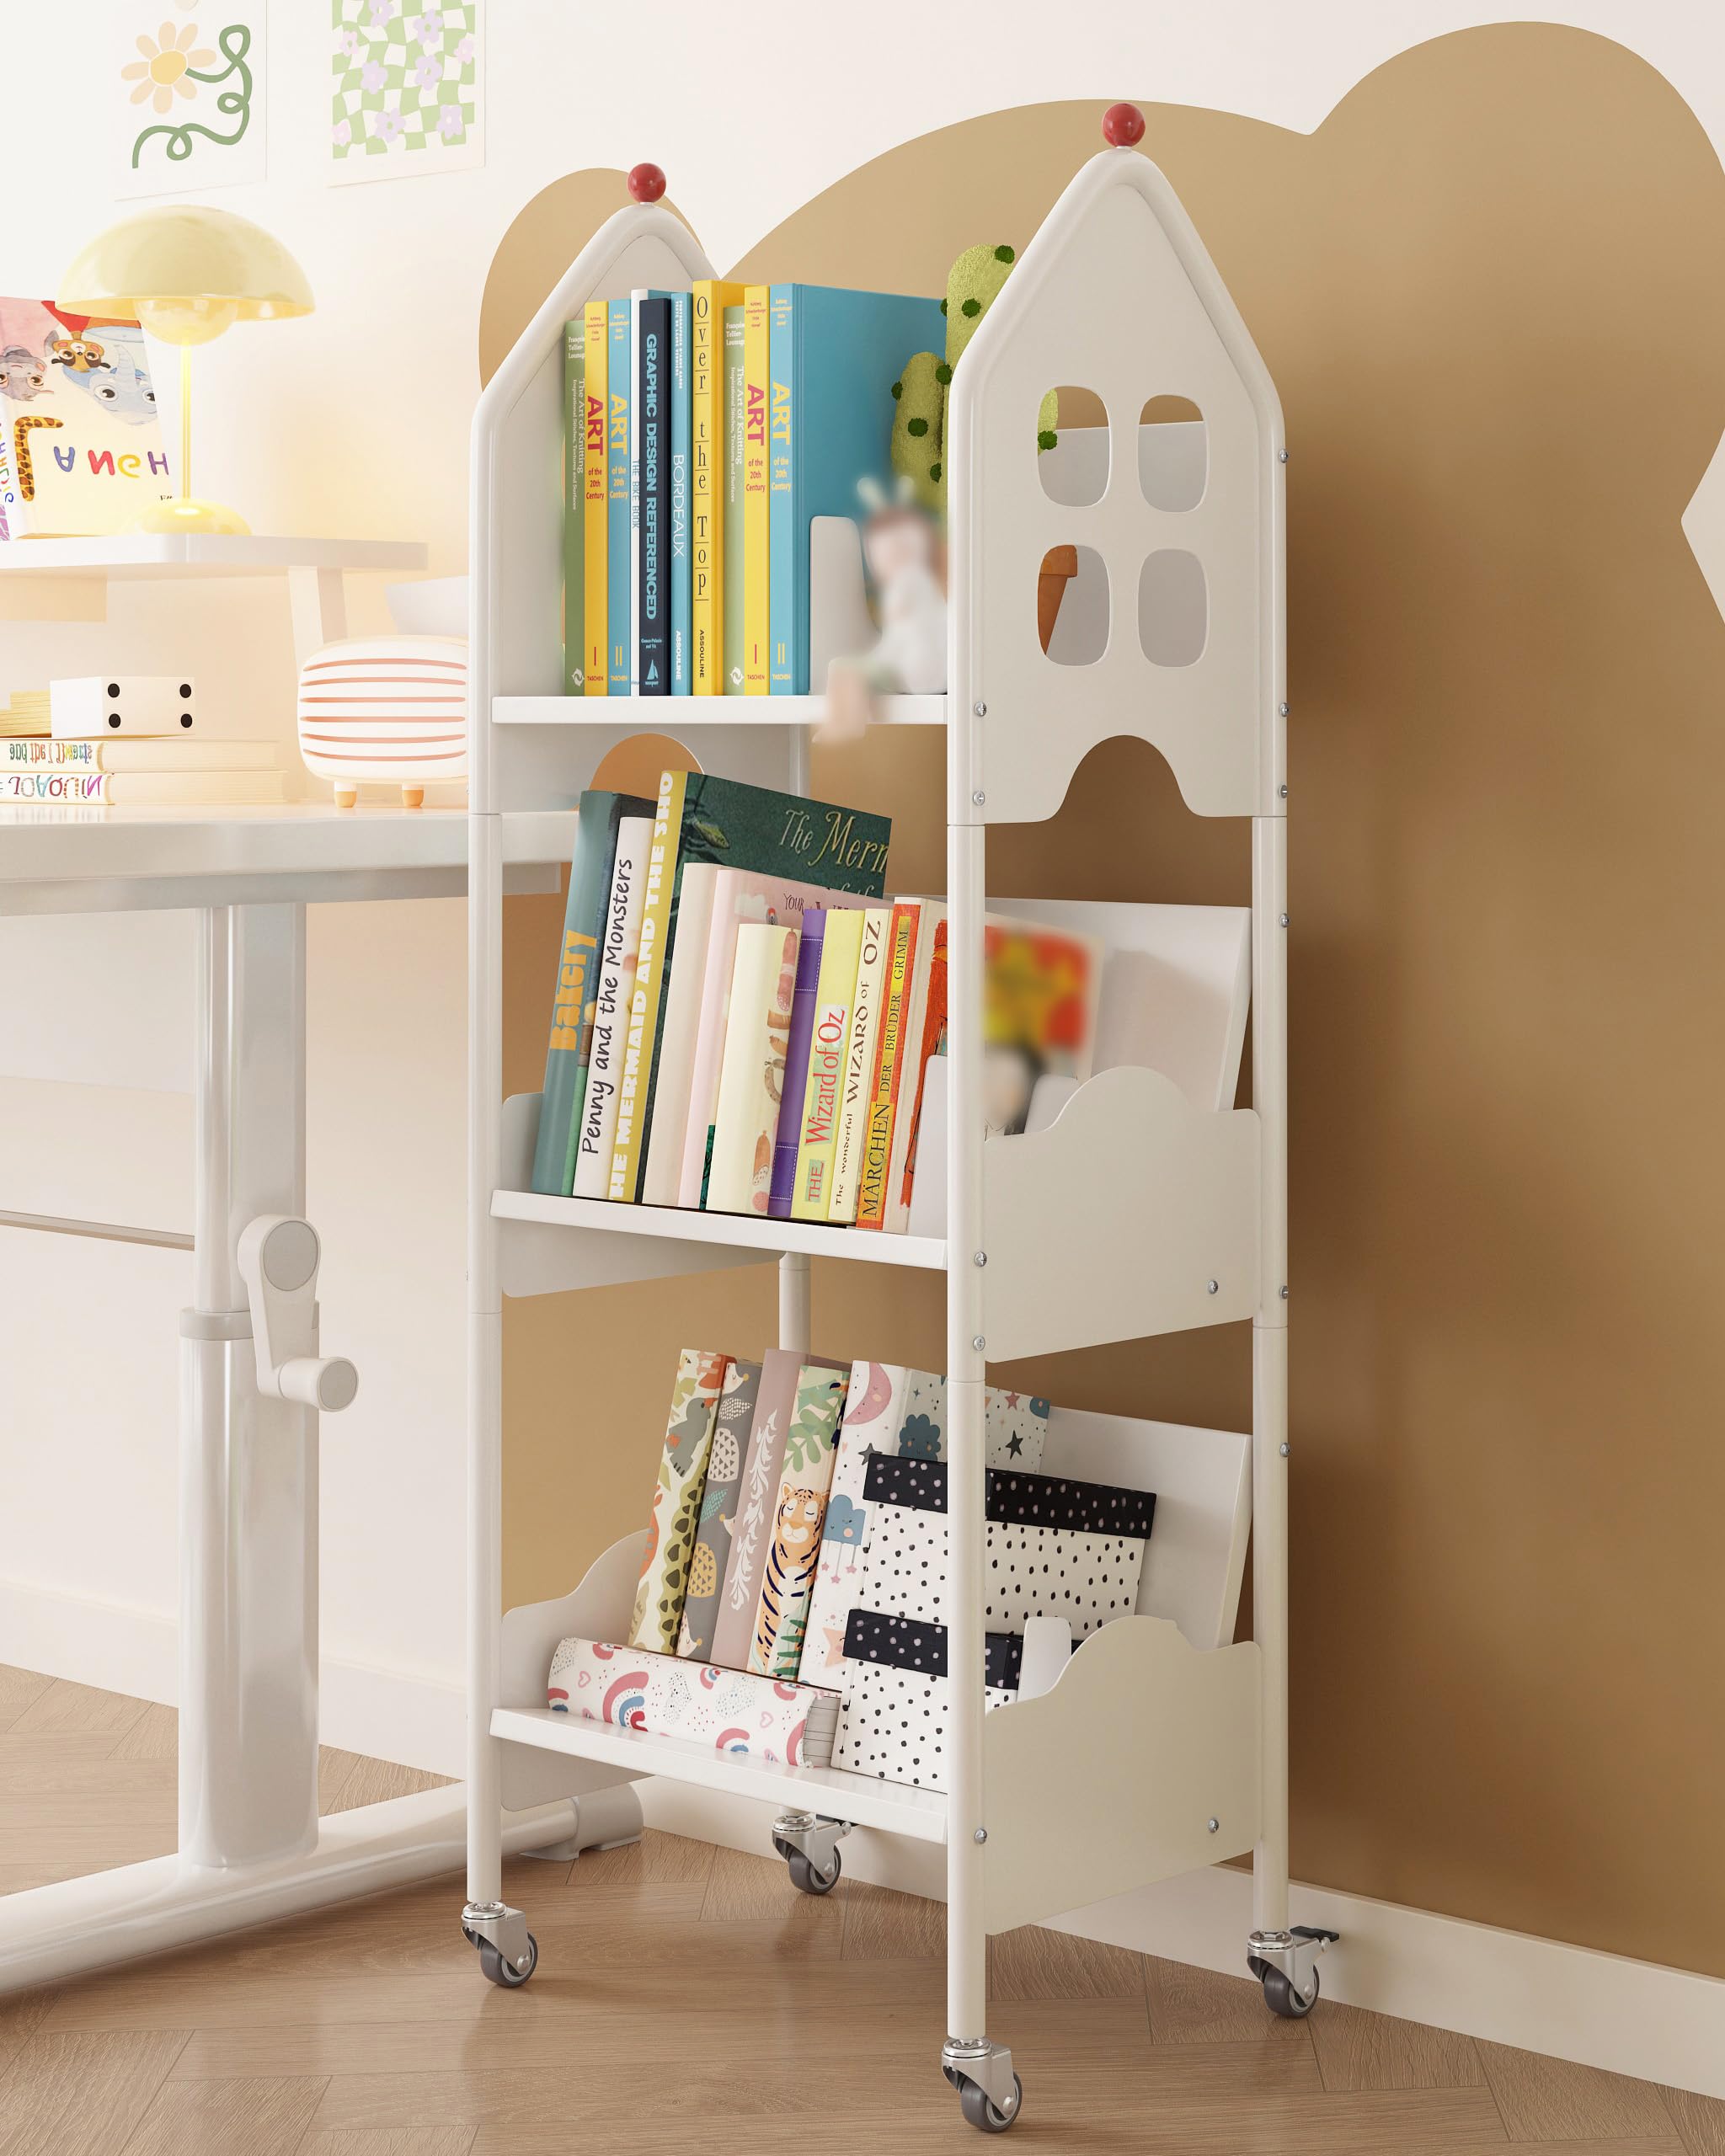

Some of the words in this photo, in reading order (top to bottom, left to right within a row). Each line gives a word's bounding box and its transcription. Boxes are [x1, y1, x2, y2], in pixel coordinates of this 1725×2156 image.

[697, 296, 708, 389] Over
[646, 334, 657, 418] GRAPHIC
[588, 396, 603, 456] ART
[611, 393, 628, 456] ART
[748, 383, 765, 446] ART
[772, 381, 790, 446] ART
[588, 467, 594, 476] of
[611, 466, 617, 475] of
[618, 465, 627, 474] the
[632, 459, 640, 477] THE
[646, 423, 657, 492] DESIGN
[748, 458, 755, 467] of
[755, 458, 763, 467] the
[750, 471, 761, 479] 20th
[586, 492, 605, 500] Century
[610, 490, 628, 500] Century
[632, 481, 640, 502] BIKE
[674, 455, 684, 558] BORDEAUX
[746, 483, 766, 492] Century
[632, 506, 640, 529] BOOK
[646, 497, 657, 620] REFERENCED
[697, 516, 708, 595] Top
[654, 772, 674, 837] SHO
[779, 808, 814, 854] The
[645, 846, 665, 910] THE
[782, 893, 804, 916] YOUR
[605, 858, 633, 966] Monsters
[637, 917, 655, 985] AND
[894, 931, 909, 979] GRIMM
[550, 930, 597, 1051] Bakery
[600, 977, 618, 1015] the
[595, 1025, 612, 1070] and
[818, 1010, 846, 1043] Oz
[884, 994, 901, 1051] BRÜDER
[617, 990, 647, 1145] MERMAID
[815, 1045, 840, 1070] of
[836, 1184, 844, 1206] The
[863, 920, 881, 965] OZ
[879, 1065, 893, 1092] DER
[582, 1080, 615, 1154] Penny
[805, 1073, 837, 1145] Wizard
[609, 1153, 628, 1199] HE
[808, 1161, 824, 1202] THE
[862, 1103, 890, 1218] MÄRCHEN
